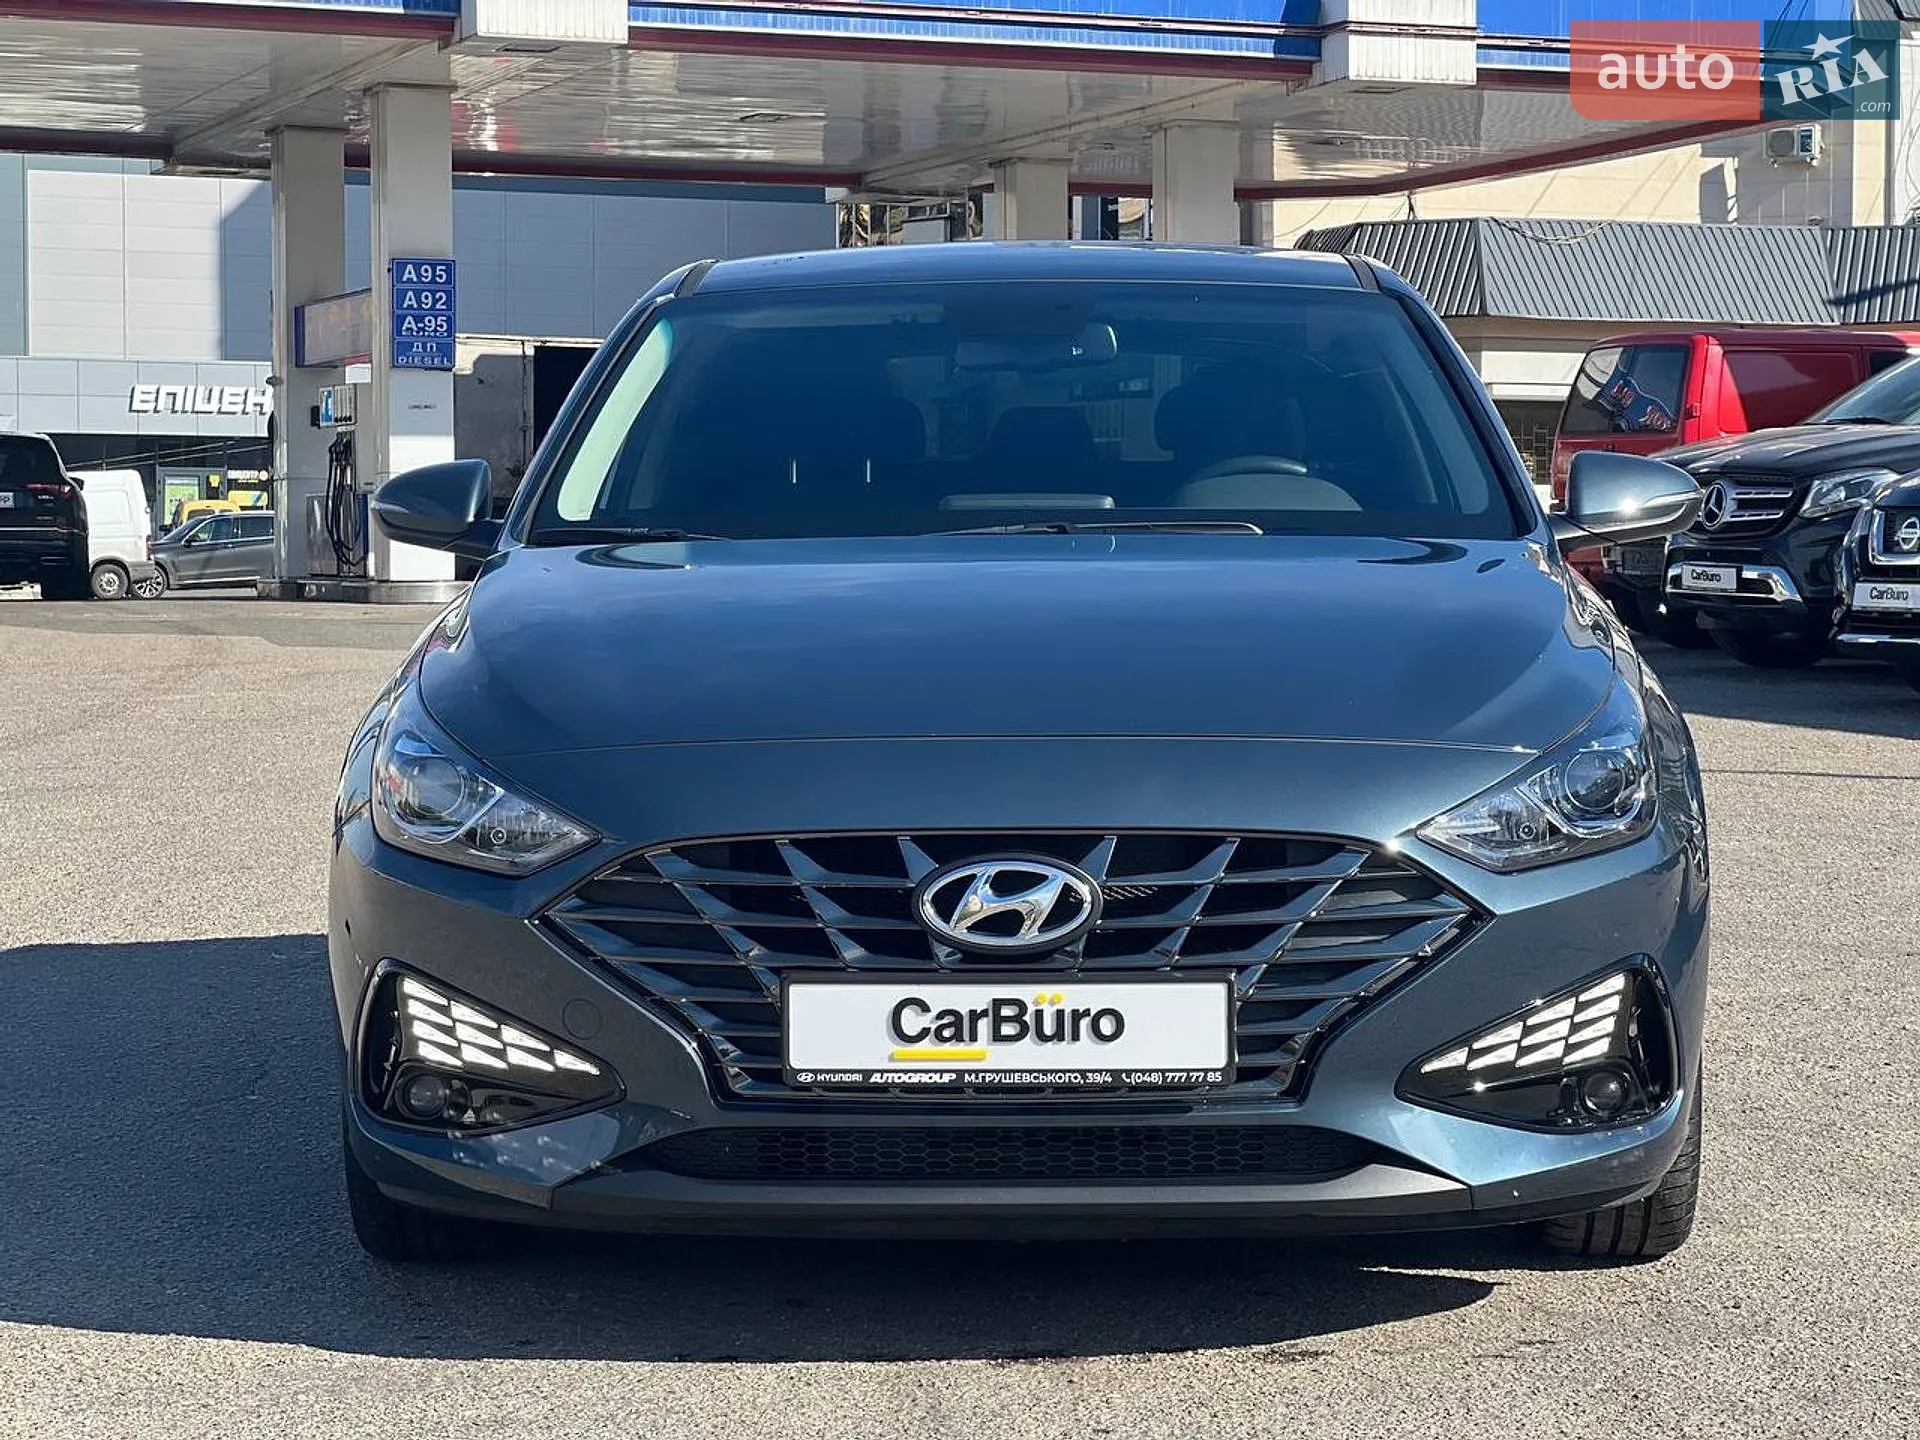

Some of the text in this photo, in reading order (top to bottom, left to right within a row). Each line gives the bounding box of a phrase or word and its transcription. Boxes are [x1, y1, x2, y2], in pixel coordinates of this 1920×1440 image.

[889, 992, 1126, 1045] CarBüro
[816, 1072, 863, 1083] HYUNDAI
[869, 1072, 957, 1083] AUTOGROUP
[1085, 1072, 1113, 1084] 39/4
[1131, 1071, 1163, 1086] (048)
[1165, 1072, 1187, 1083] 777
[1190, 1072, 1205, 1083] 77
[1206, 1071, 1223, 1083] 85
